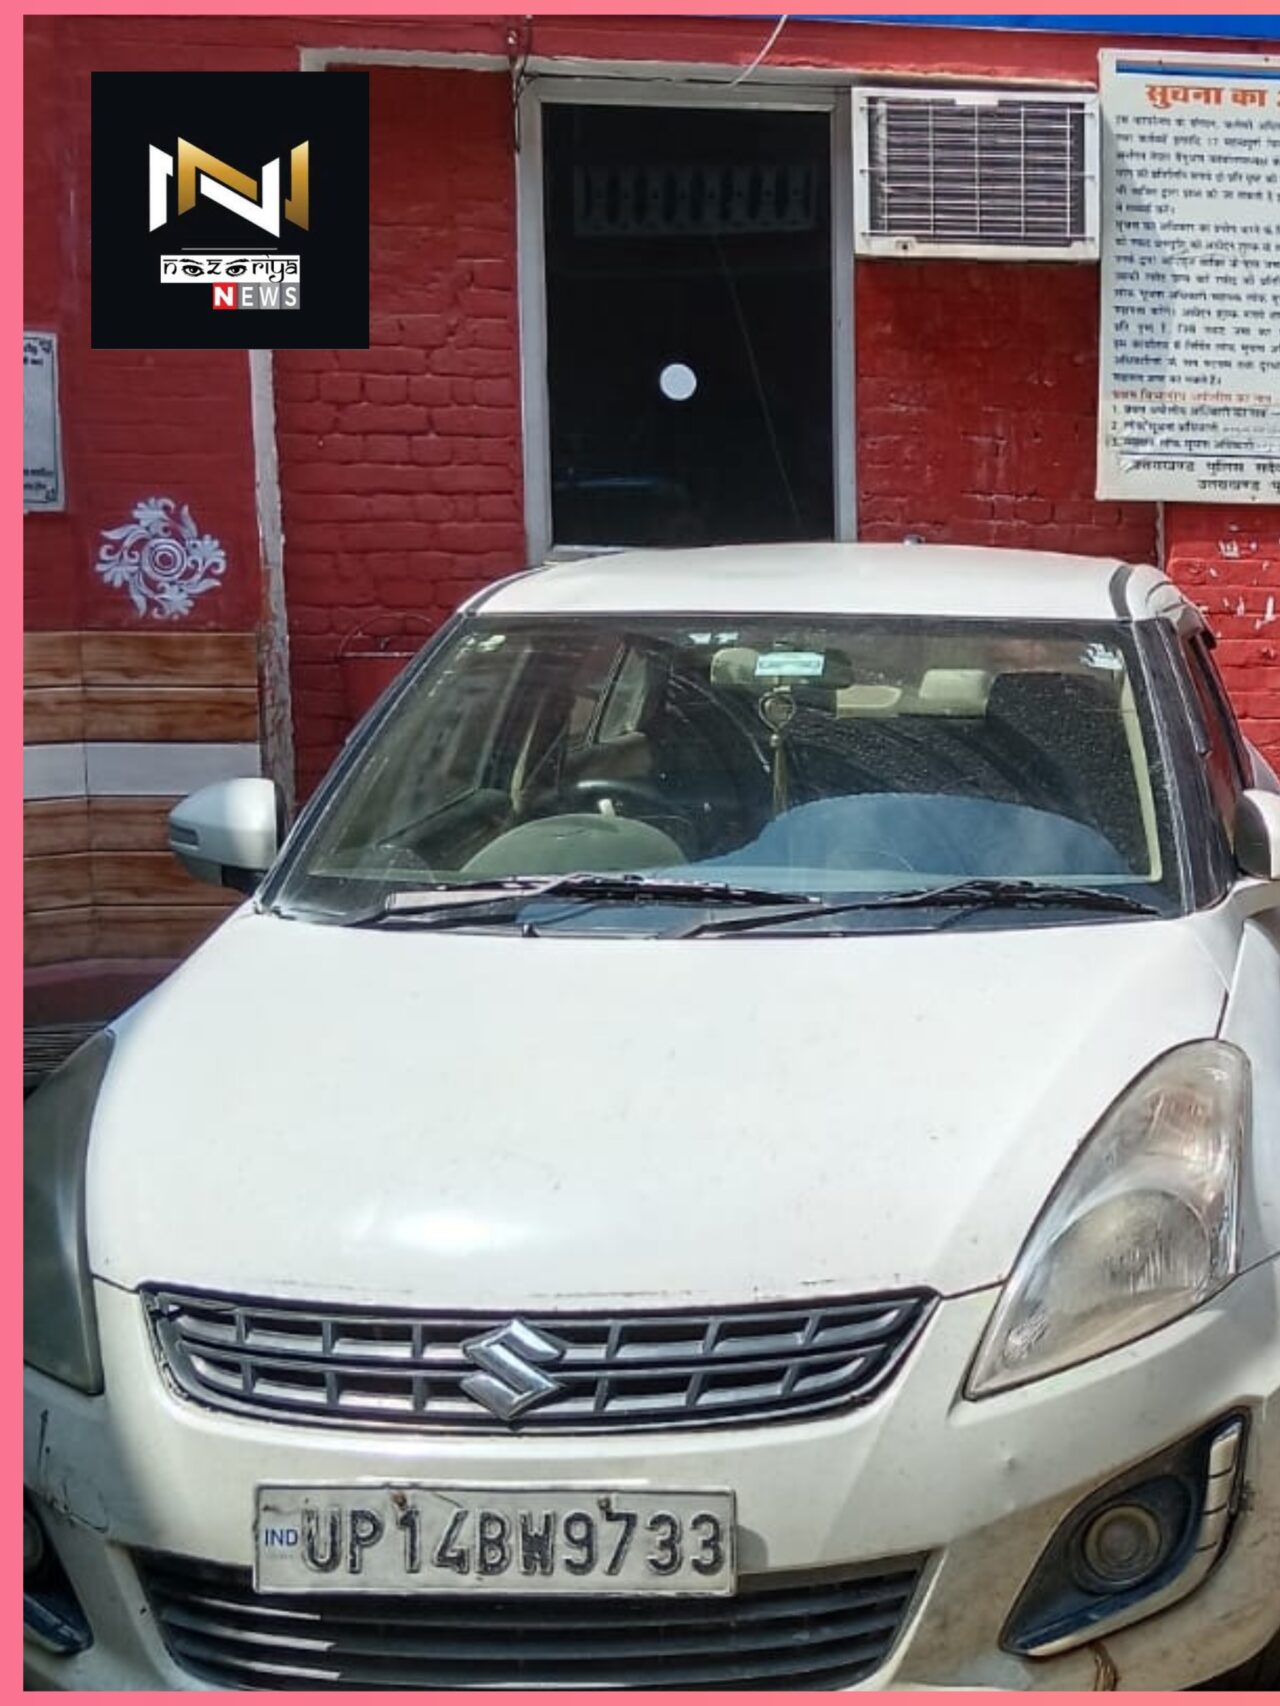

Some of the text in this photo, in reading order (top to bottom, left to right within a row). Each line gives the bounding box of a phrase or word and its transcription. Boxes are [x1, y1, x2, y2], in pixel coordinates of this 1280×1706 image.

[1231, 88, 1268, 107] का
[265, 1507, 725, 1576] IND UP14BW9733
